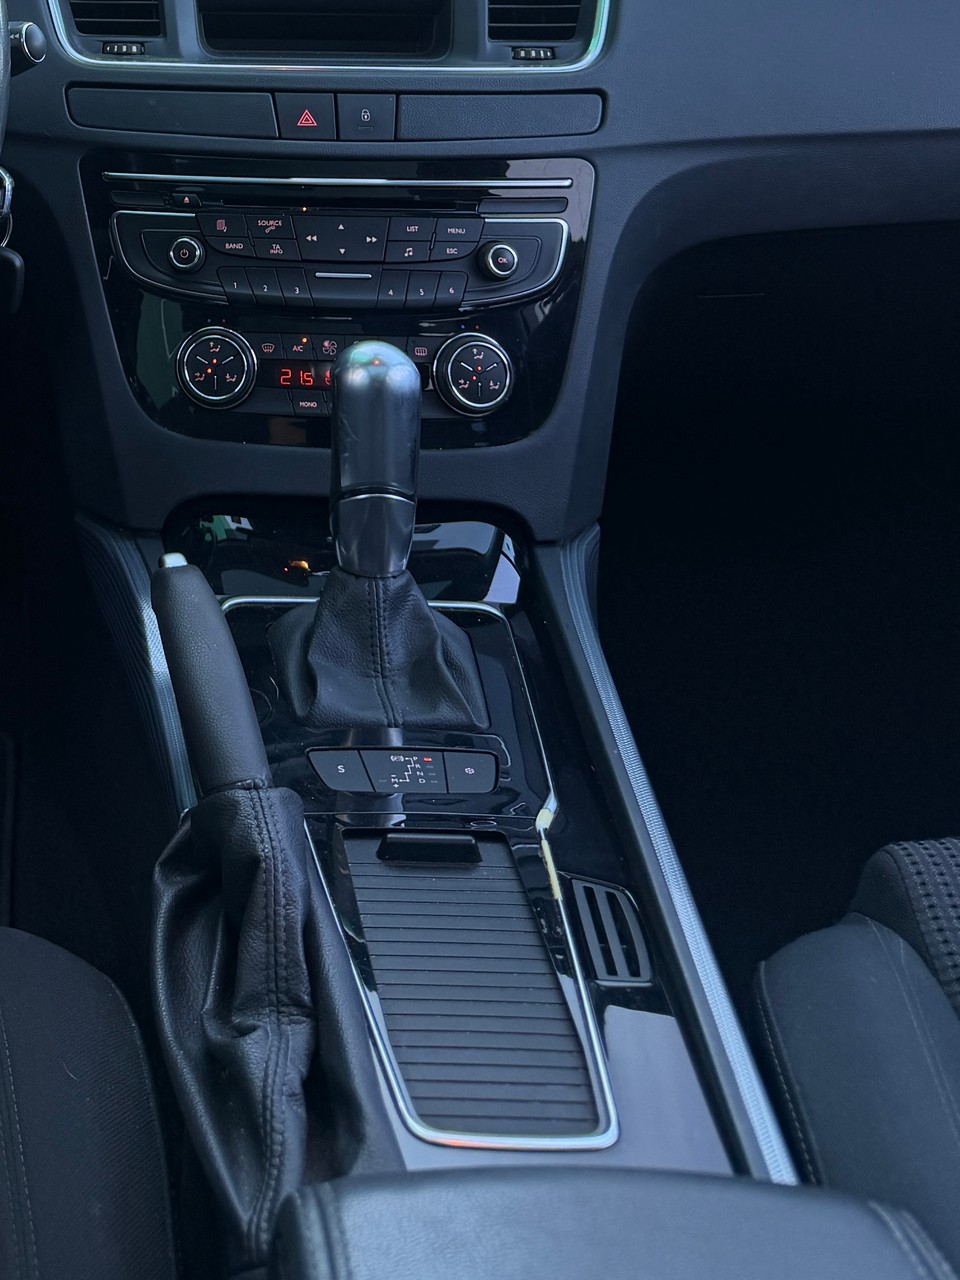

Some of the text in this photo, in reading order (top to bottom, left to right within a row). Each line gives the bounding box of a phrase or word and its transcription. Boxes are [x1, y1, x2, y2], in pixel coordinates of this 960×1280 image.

[257, 219, 283, 227] SOURCE
[406, 225, 419, 233] LIST
[263, 284, 268, 292] 2
[294, 286, 299, 294] 3
[337, 765, 345, 774] S
